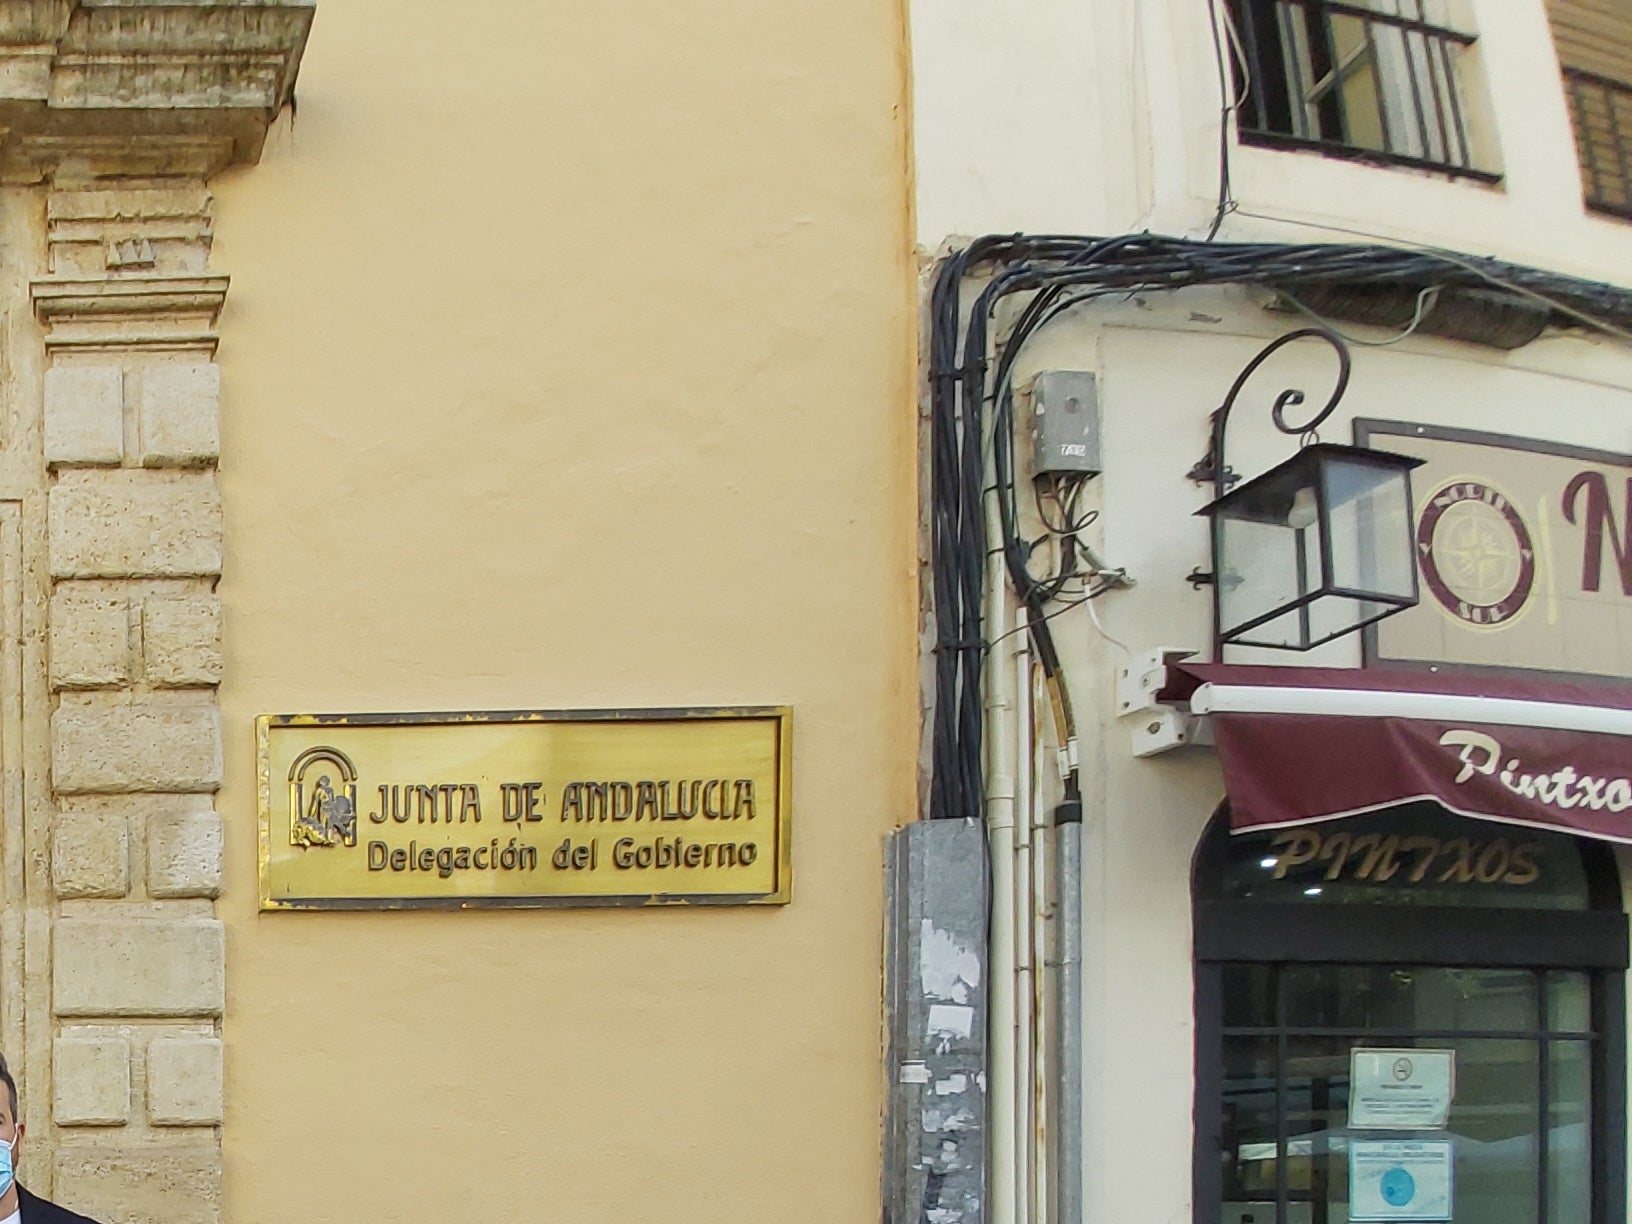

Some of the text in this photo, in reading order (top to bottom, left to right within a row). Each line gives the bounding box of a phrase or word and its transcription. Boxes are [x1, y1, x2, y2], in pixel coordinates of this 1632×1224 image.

[369, 779, 757, 823] JUNTA DE ANDALUCIA
[368, 836, 758, 878] Delegación del Gobierno
[1272, 829, 1540, 885] PINTXOS
